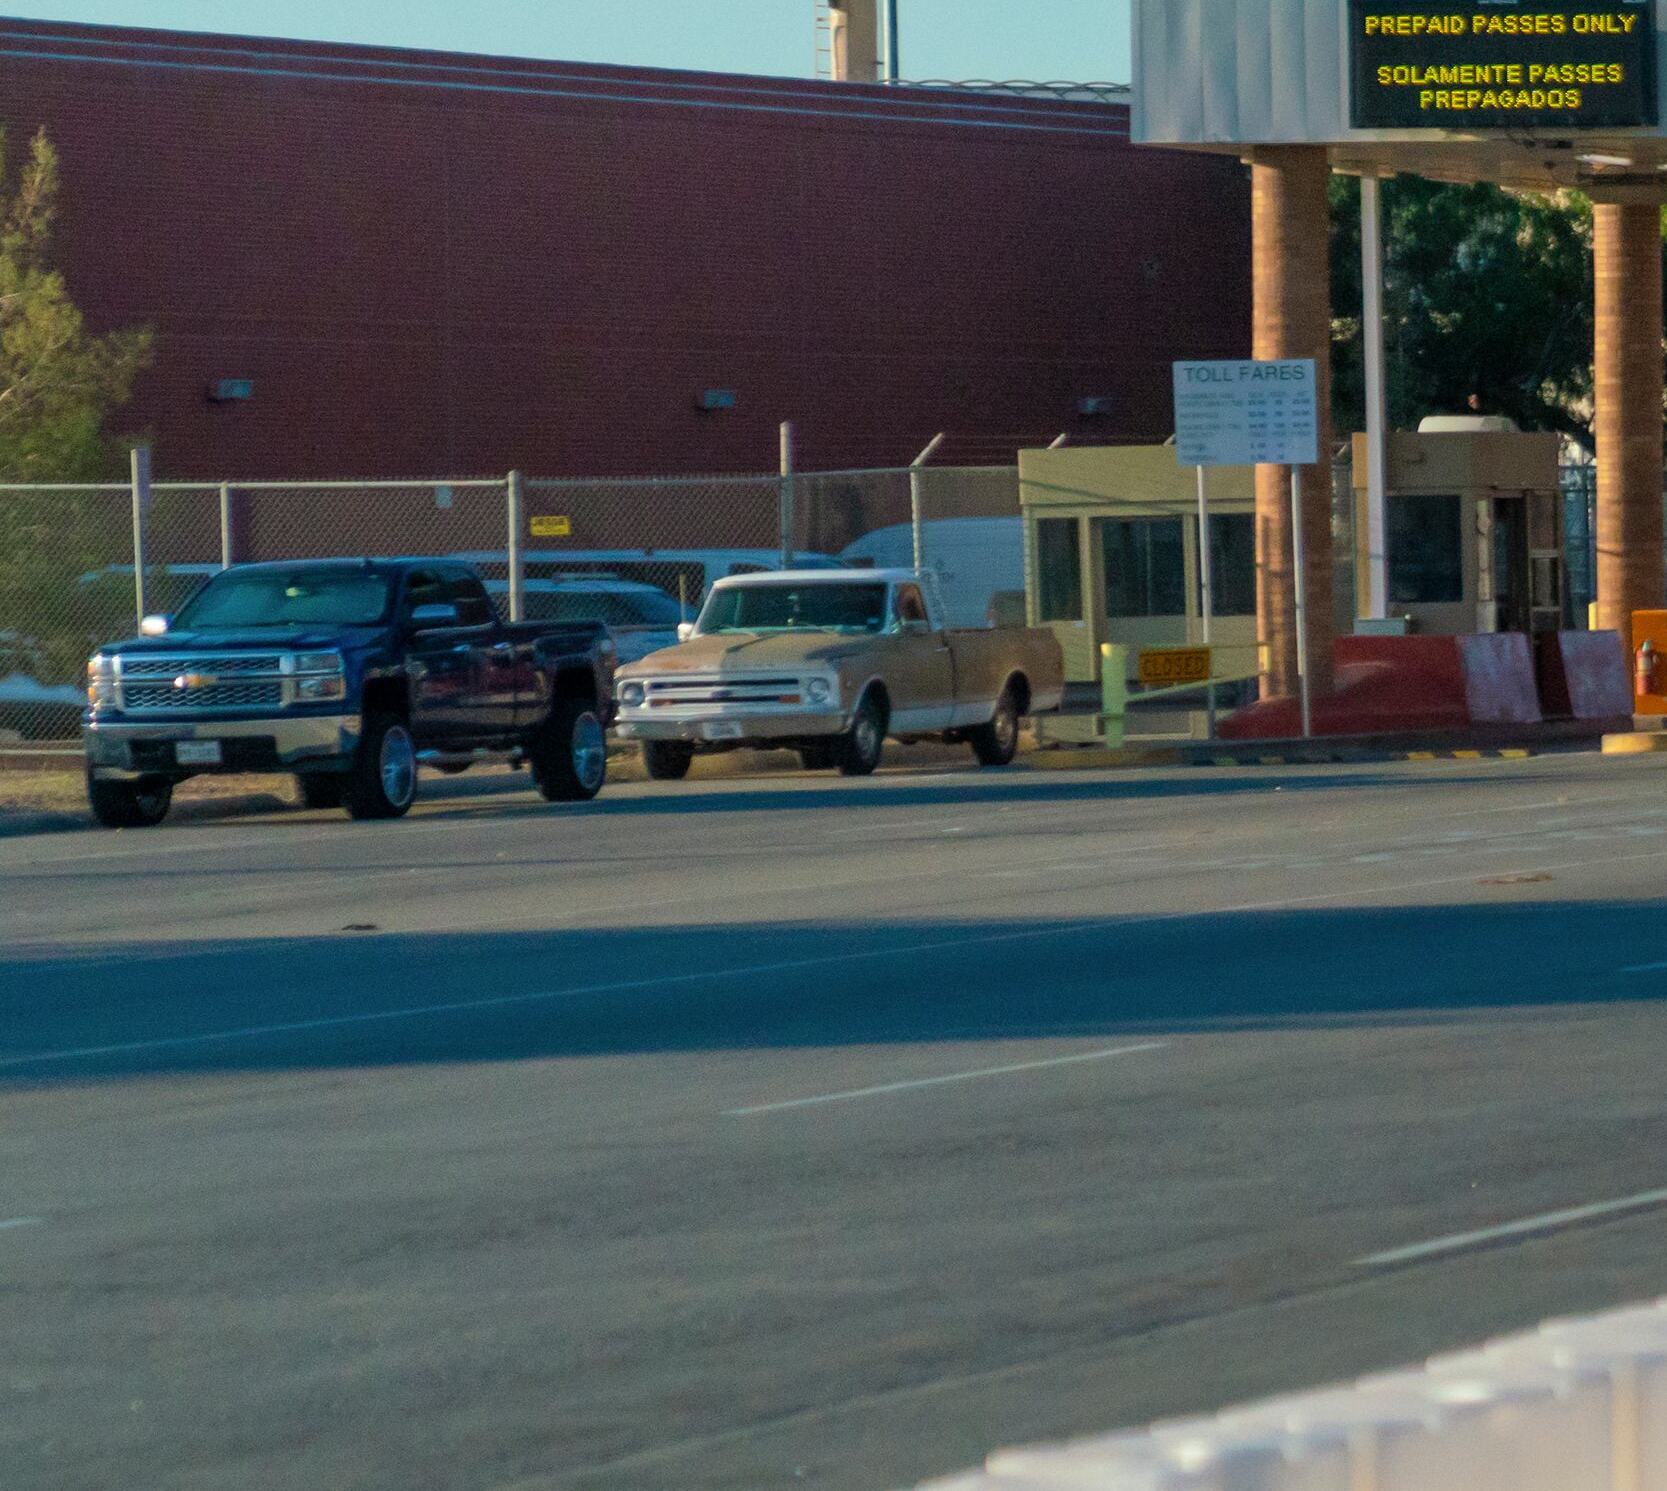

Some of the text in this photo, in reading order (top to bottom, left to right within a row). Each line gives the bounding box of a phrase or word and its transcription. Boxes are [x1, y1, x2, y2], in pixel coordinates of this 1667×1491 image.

[1366, 14, 1635, 34] PREPAID PASSES ONLY
[1378, 64, 1622, 84] SOLAMENTE PASSES
[1420, 90, 1580, 109] PREPAGADOS
[1183, 365, 1306, 384] TOLL FARES
